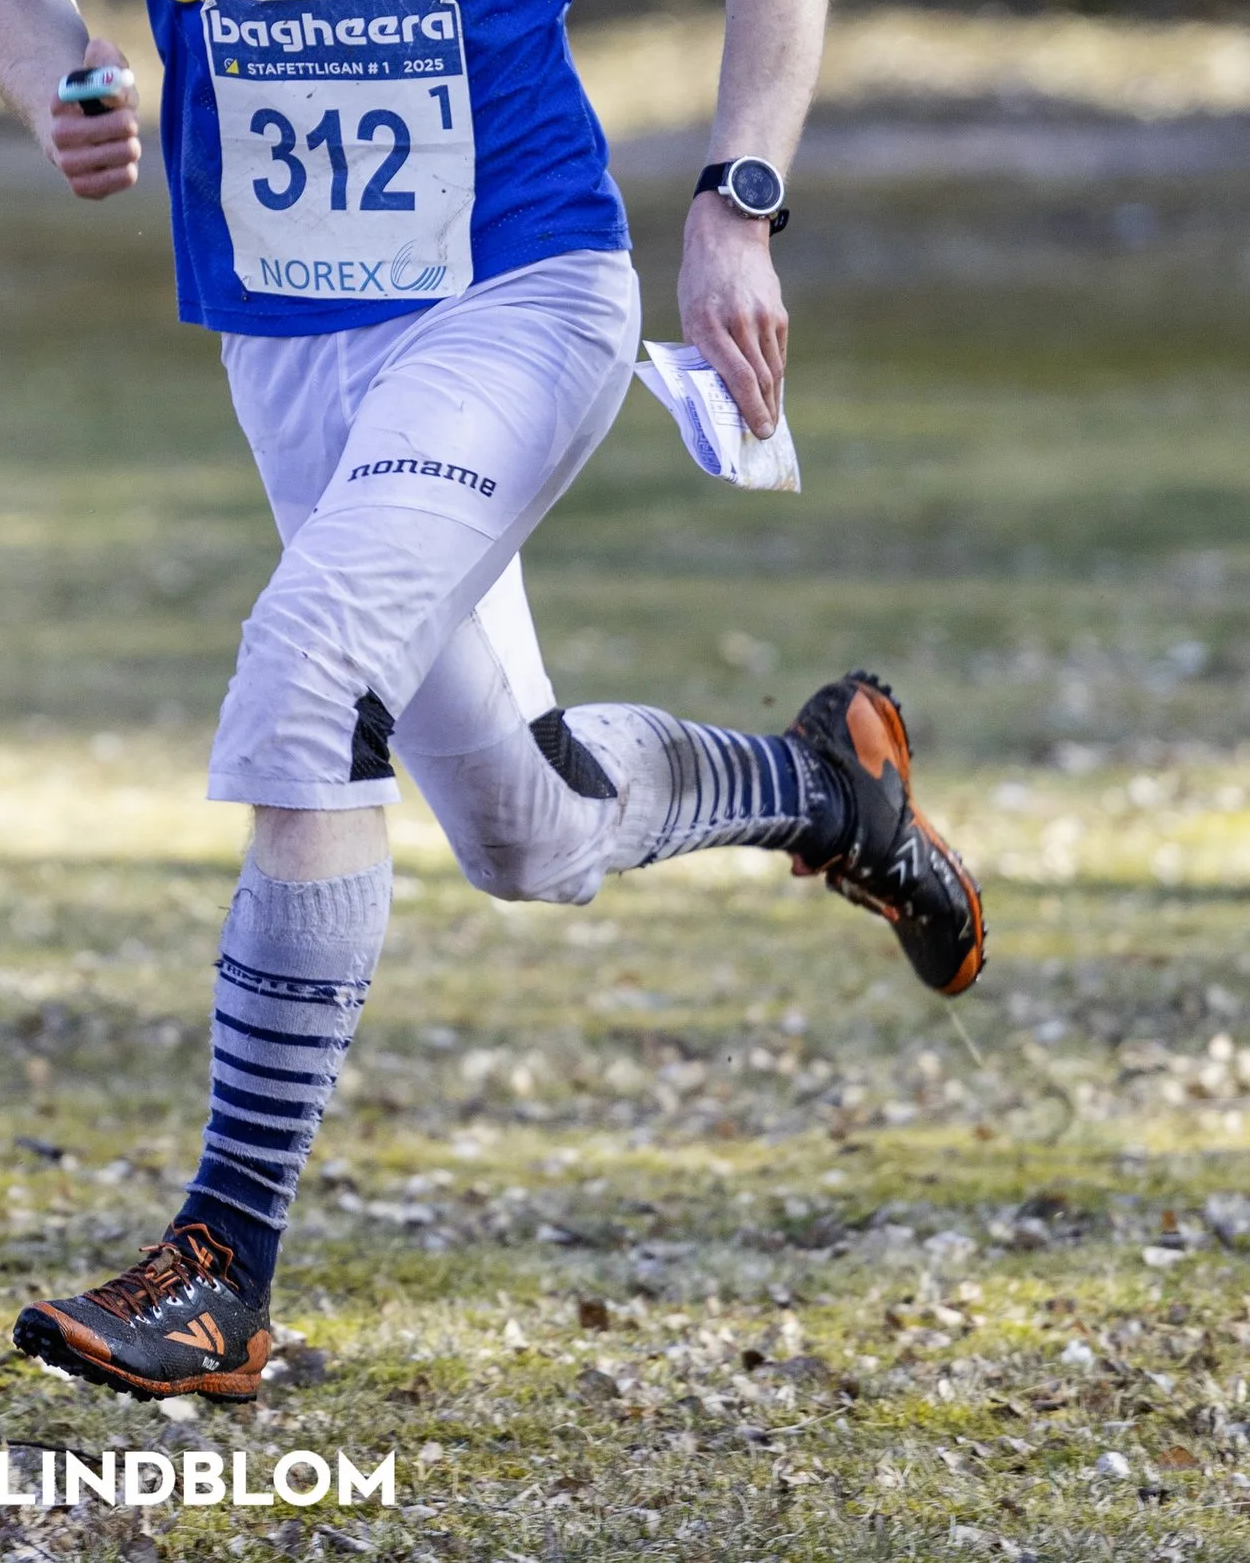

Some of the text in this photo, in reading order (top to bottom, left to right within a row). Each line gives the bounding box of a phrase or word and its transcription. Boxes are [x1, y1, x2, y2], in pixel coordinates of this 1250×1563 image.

[211, 9, 454, 52] bagheera
[247, 58, 444, 76] STAFETTLIGAN # 1 2025
[428, 84, 453, 130] 1
[250, 107, 415, 211] 312
[260, 258, 385, 292] NOREX
[347, 458, 498, 498] noname
